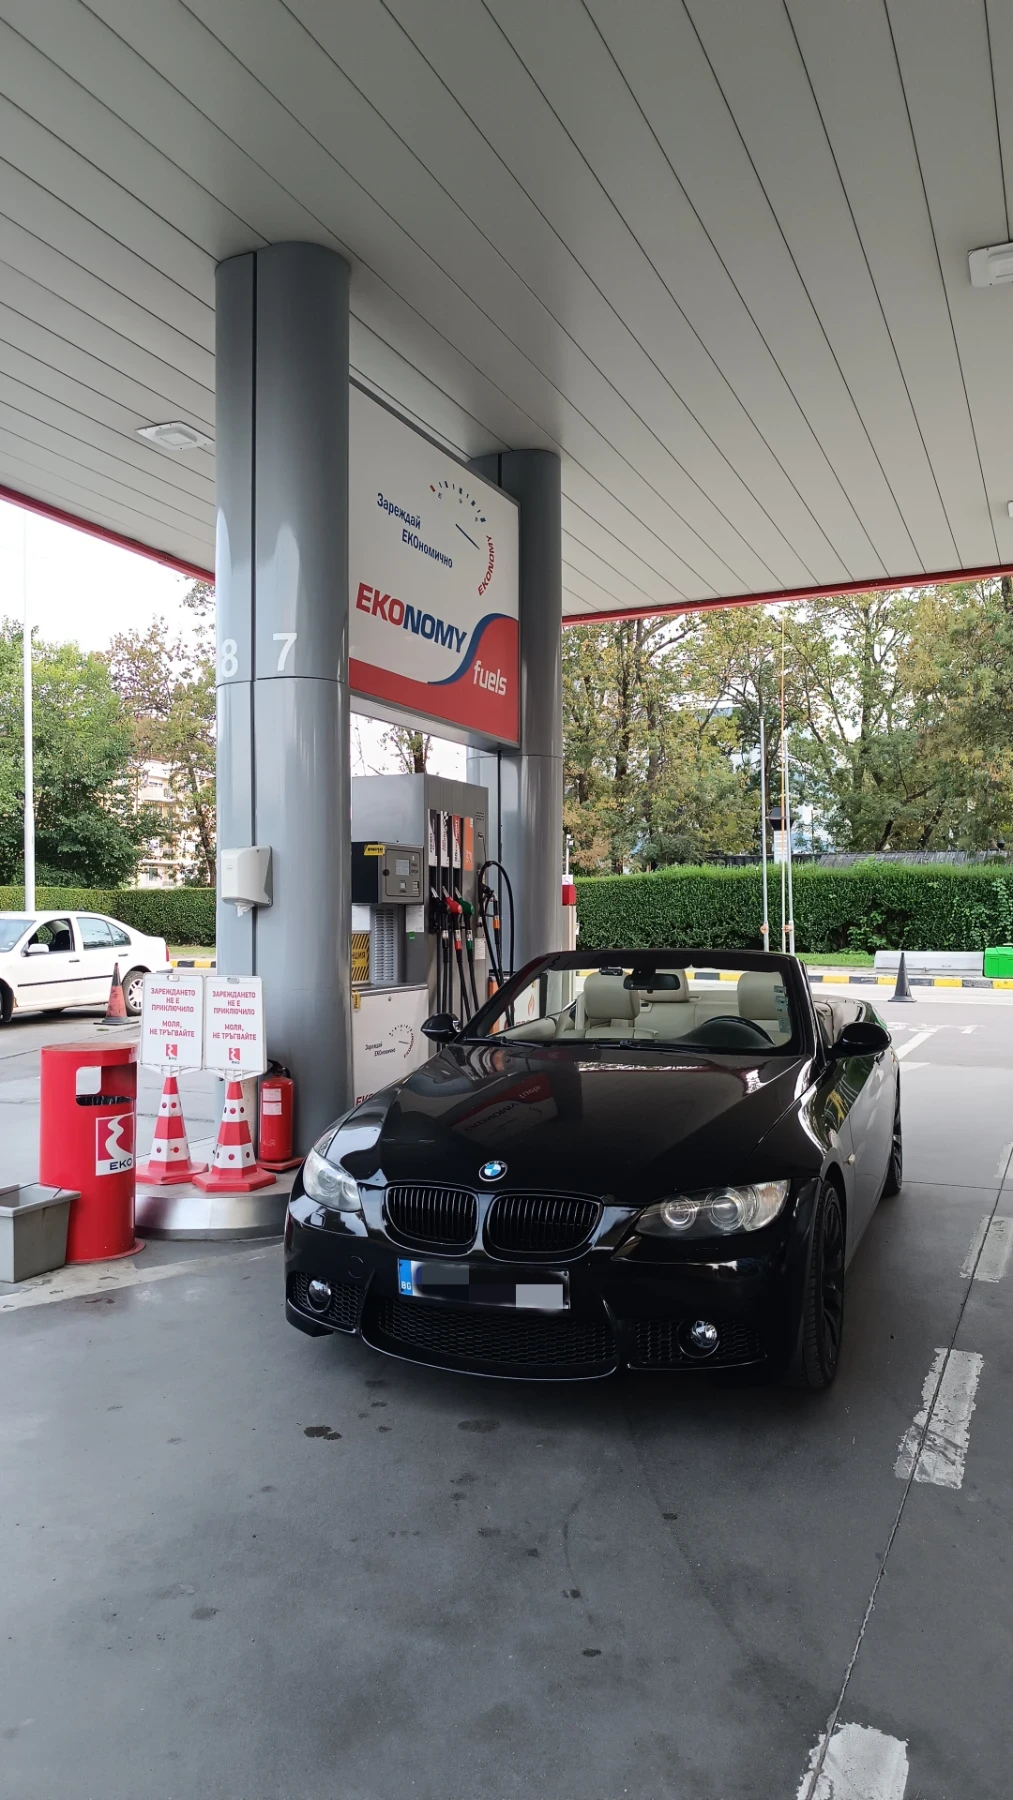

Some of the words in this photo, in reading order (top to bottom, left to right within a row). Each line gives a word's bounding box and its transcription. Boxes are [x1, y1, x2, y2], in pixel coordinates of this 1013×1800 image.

[377, 493, 421, 530] Зареждай
[402, 528, 453, 568] ЕКОномично
[478, 535, 495, 596] EKONOMY
[356, 582, 467, 653] EKONOMY
[272, 632, 297, 671] 7
[221, 638, 238, 678] 8
[473, 660, 507, 696] fuels
[150, 988, 196, 997] ЗАРЕЖДАНЕТО
[212, 990, 256, 999] ЗАРЕЖДАНЕТО
[151, 1004, 194, 1012] ПРИКЛЮЧИЛО
[213, 1007, 255, 1015] ПРИКЛЮЧИЛО
[162, 1020, 182, 1028] МОЛЯ,
[224, 1023, 244, 1032] МОЛЯ,
[159, 1028, 195, 1038] ТРЪГВАЙТЕ
[222, 1032, 257, 1041] ТРЪГВАЙТЕ
[109, 1157, 132, 1171] EKO
[401, 1281, 412, 1290] BG
